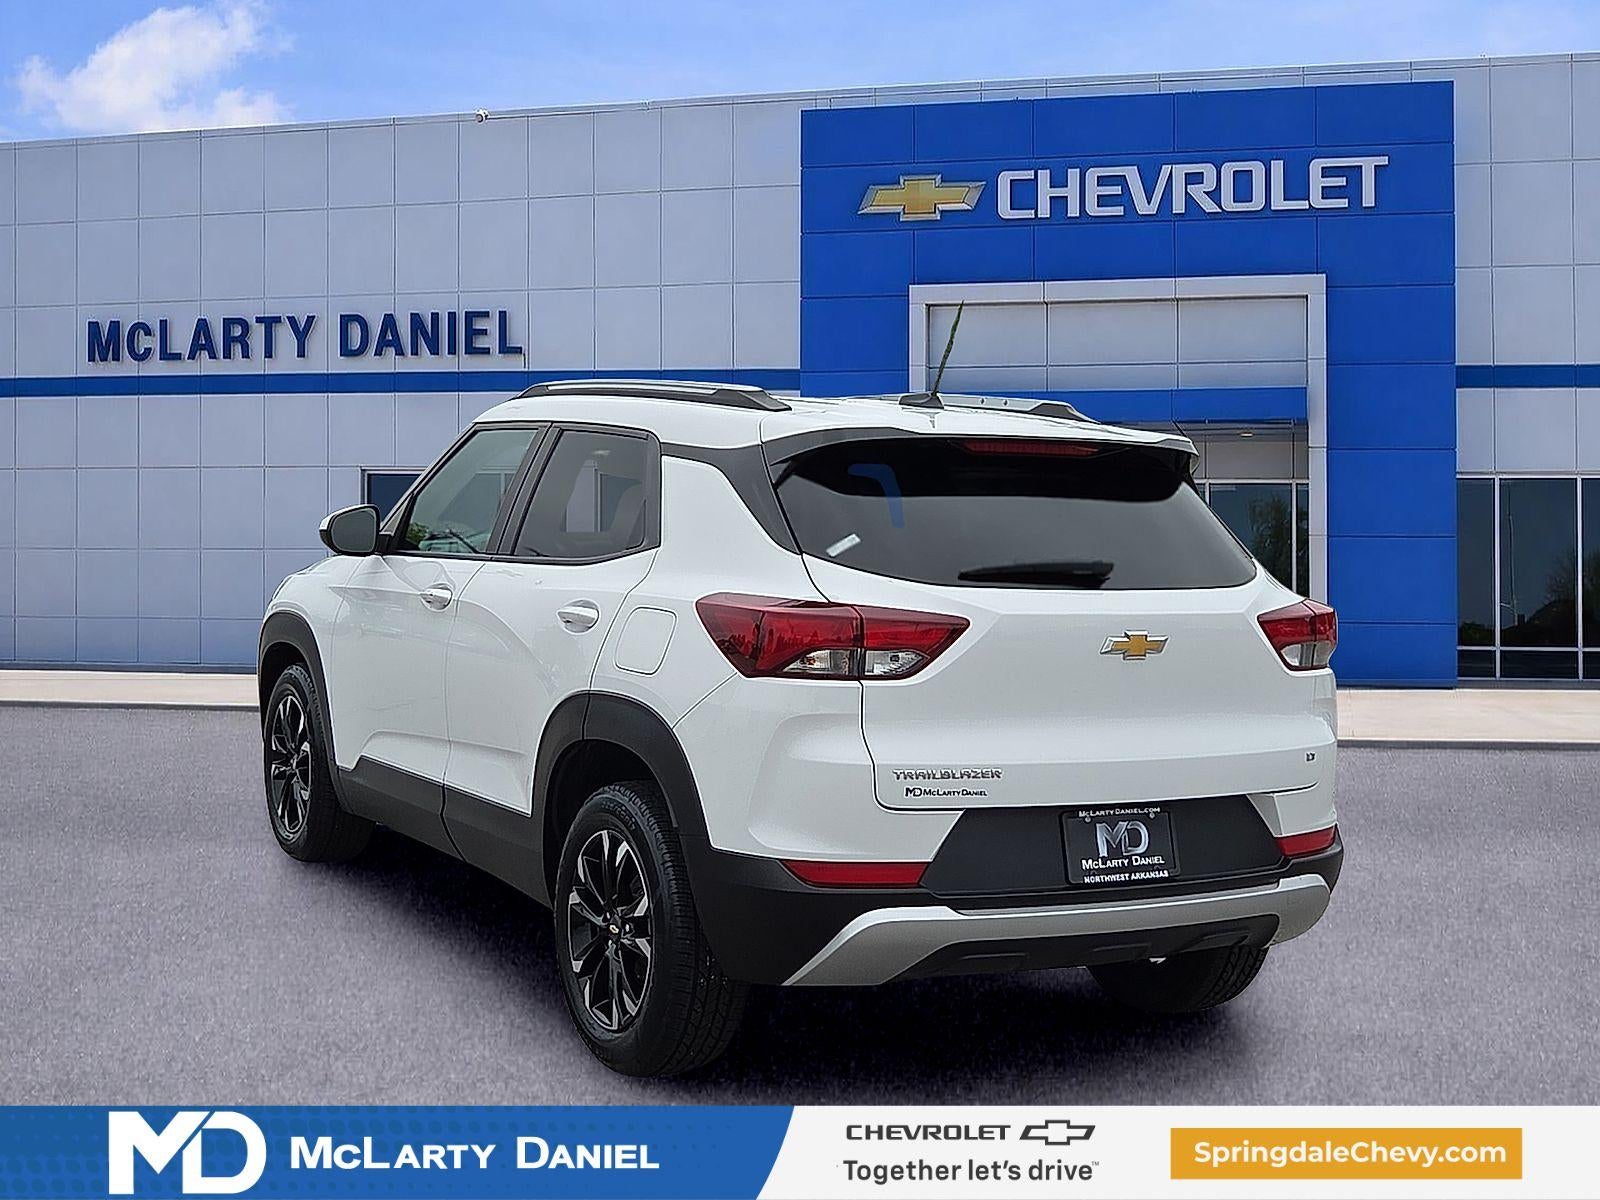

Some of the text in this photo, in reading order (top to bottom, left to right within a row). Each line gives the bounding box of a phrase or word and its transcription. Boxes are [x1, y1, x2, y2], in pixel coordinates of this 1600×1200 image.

[997, 156, 1389, 219] CHEVROLET
[339, 310, 523, 357] DANIEL
[893, 767, 1002, 781] TRAILBLAZER
[1131, 855, 1166, 866] DANIEL
[1083, 870, 1170, 884] NORTHWEST ARKANSAS
